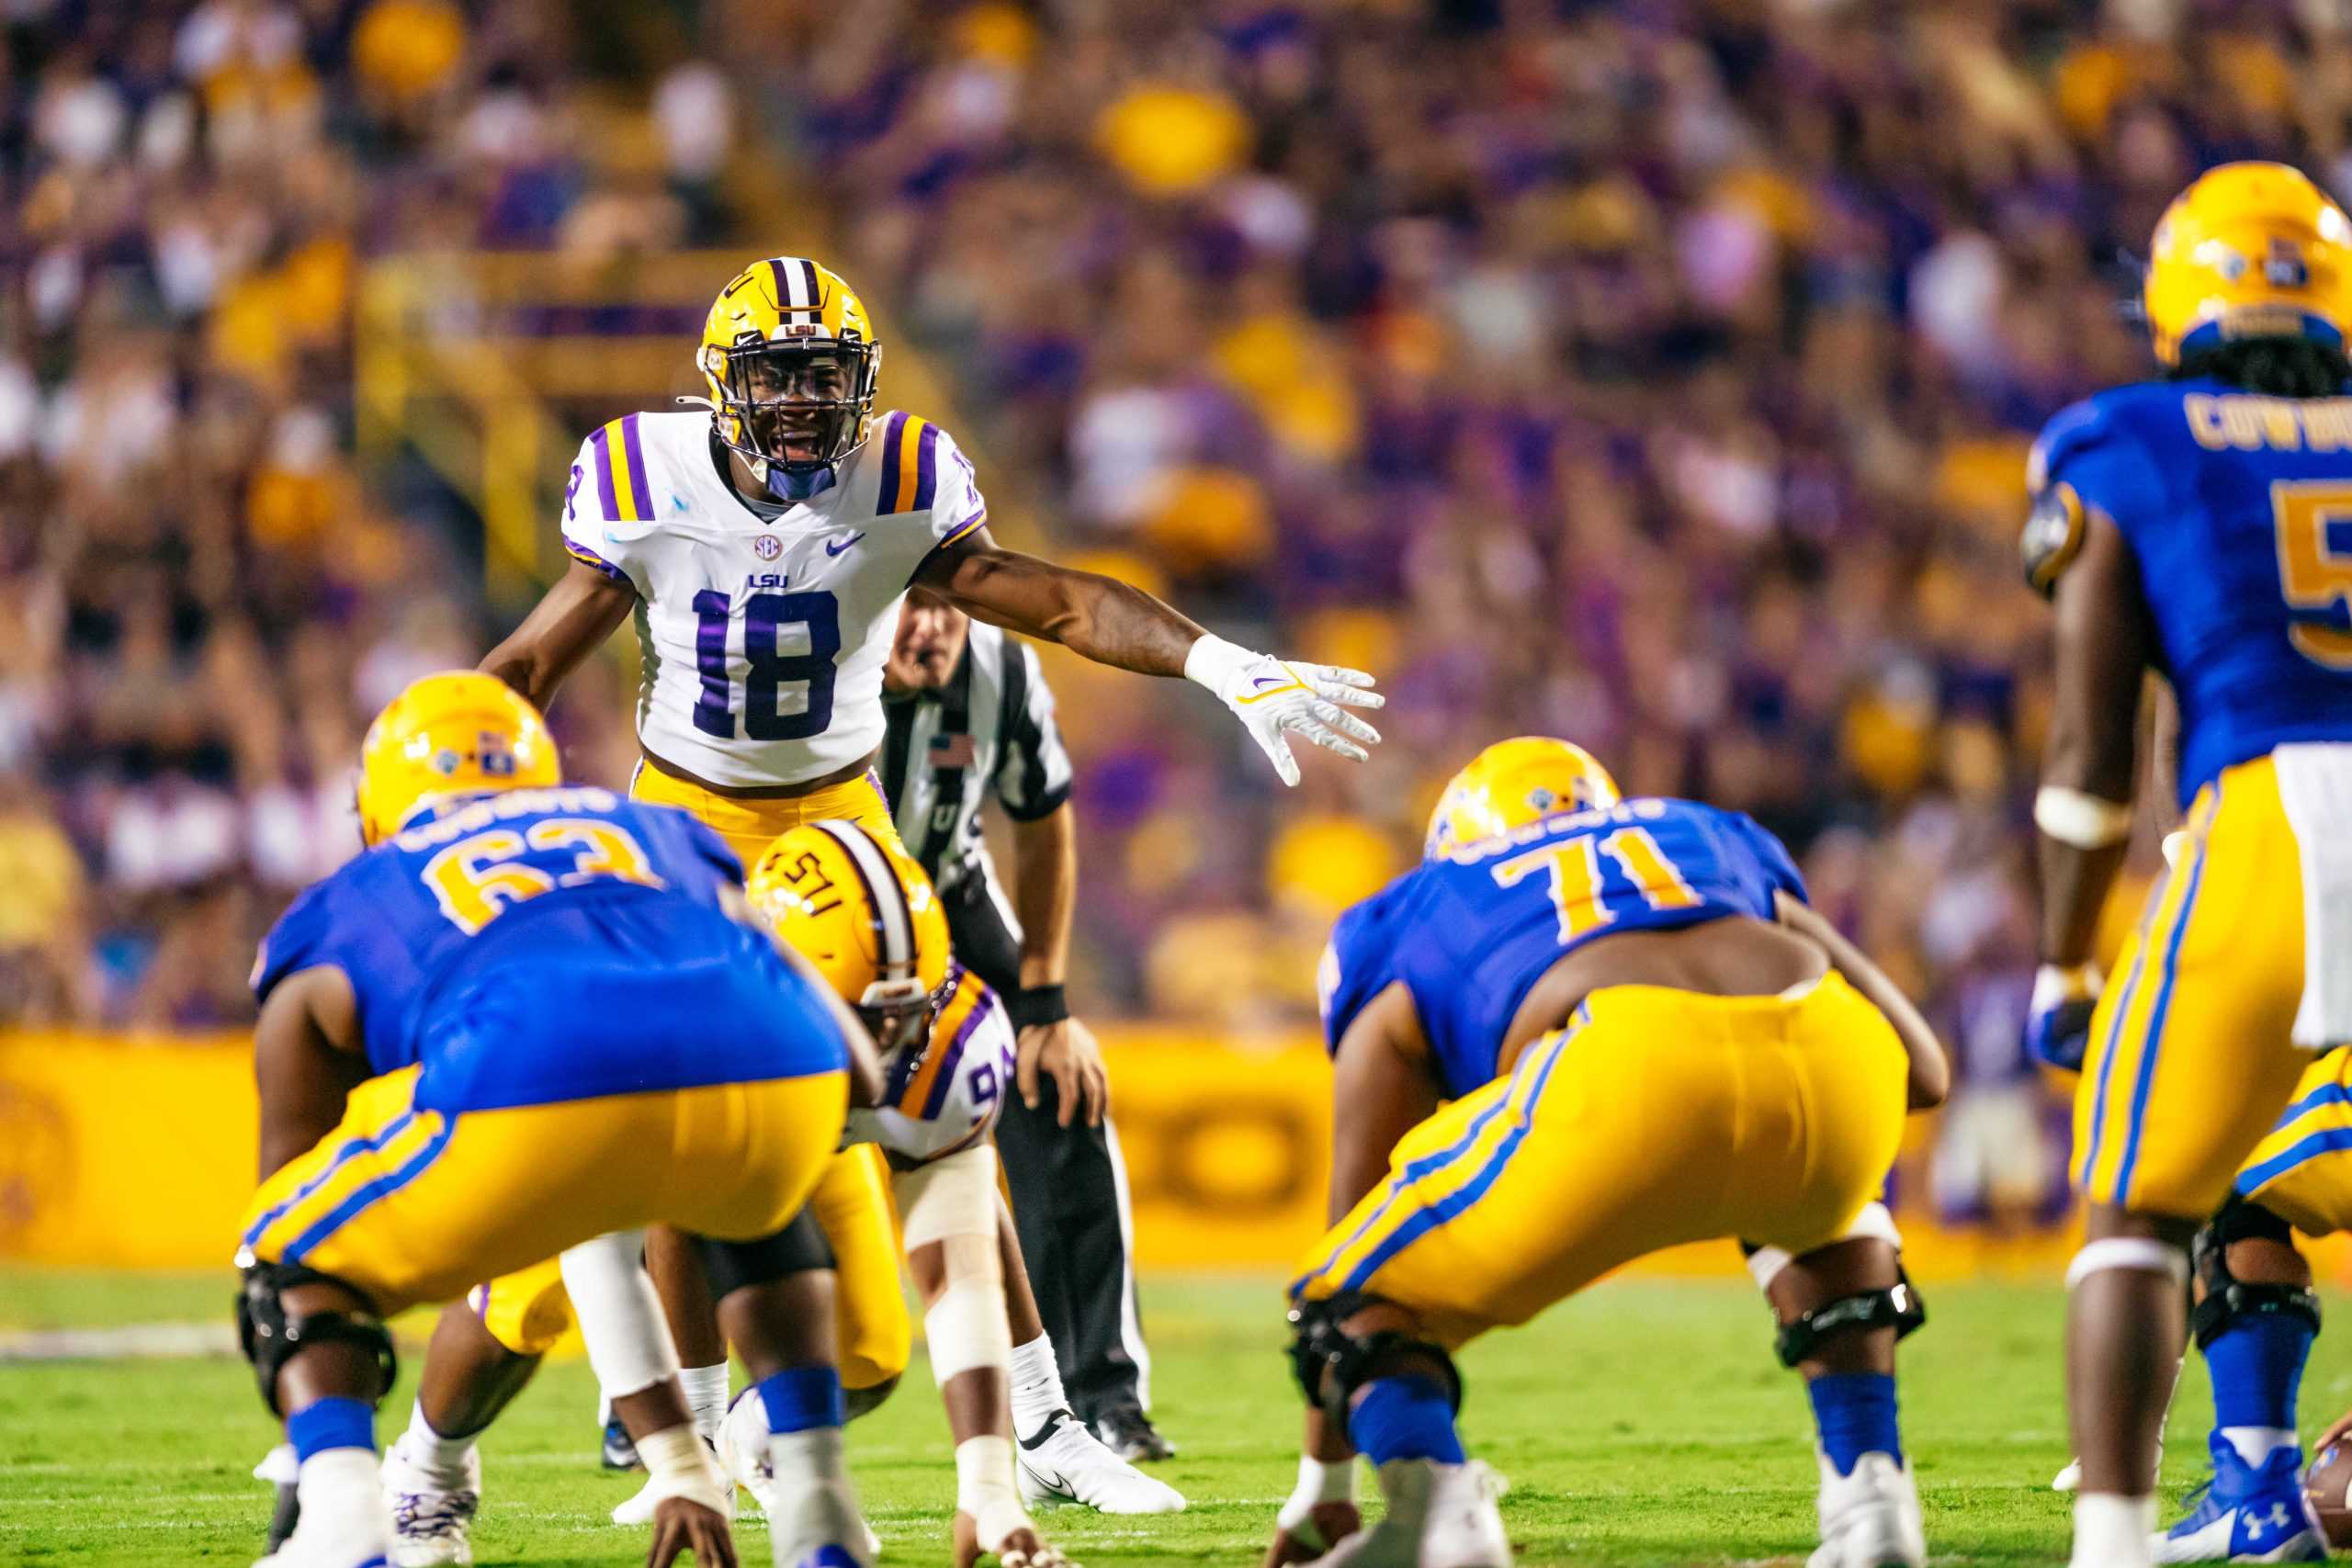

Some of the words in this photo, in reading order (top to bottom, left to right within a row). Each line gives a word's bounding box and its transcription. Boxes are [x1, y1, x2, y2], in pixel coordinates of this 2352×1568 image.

[786, 324, 816, 337] LSU
[748, 574, 788, 589] LSU
[692, 589, 841, 741] 18
[421, 818, 669, 937] 63
[1490, 827, 1706, 946] 71
